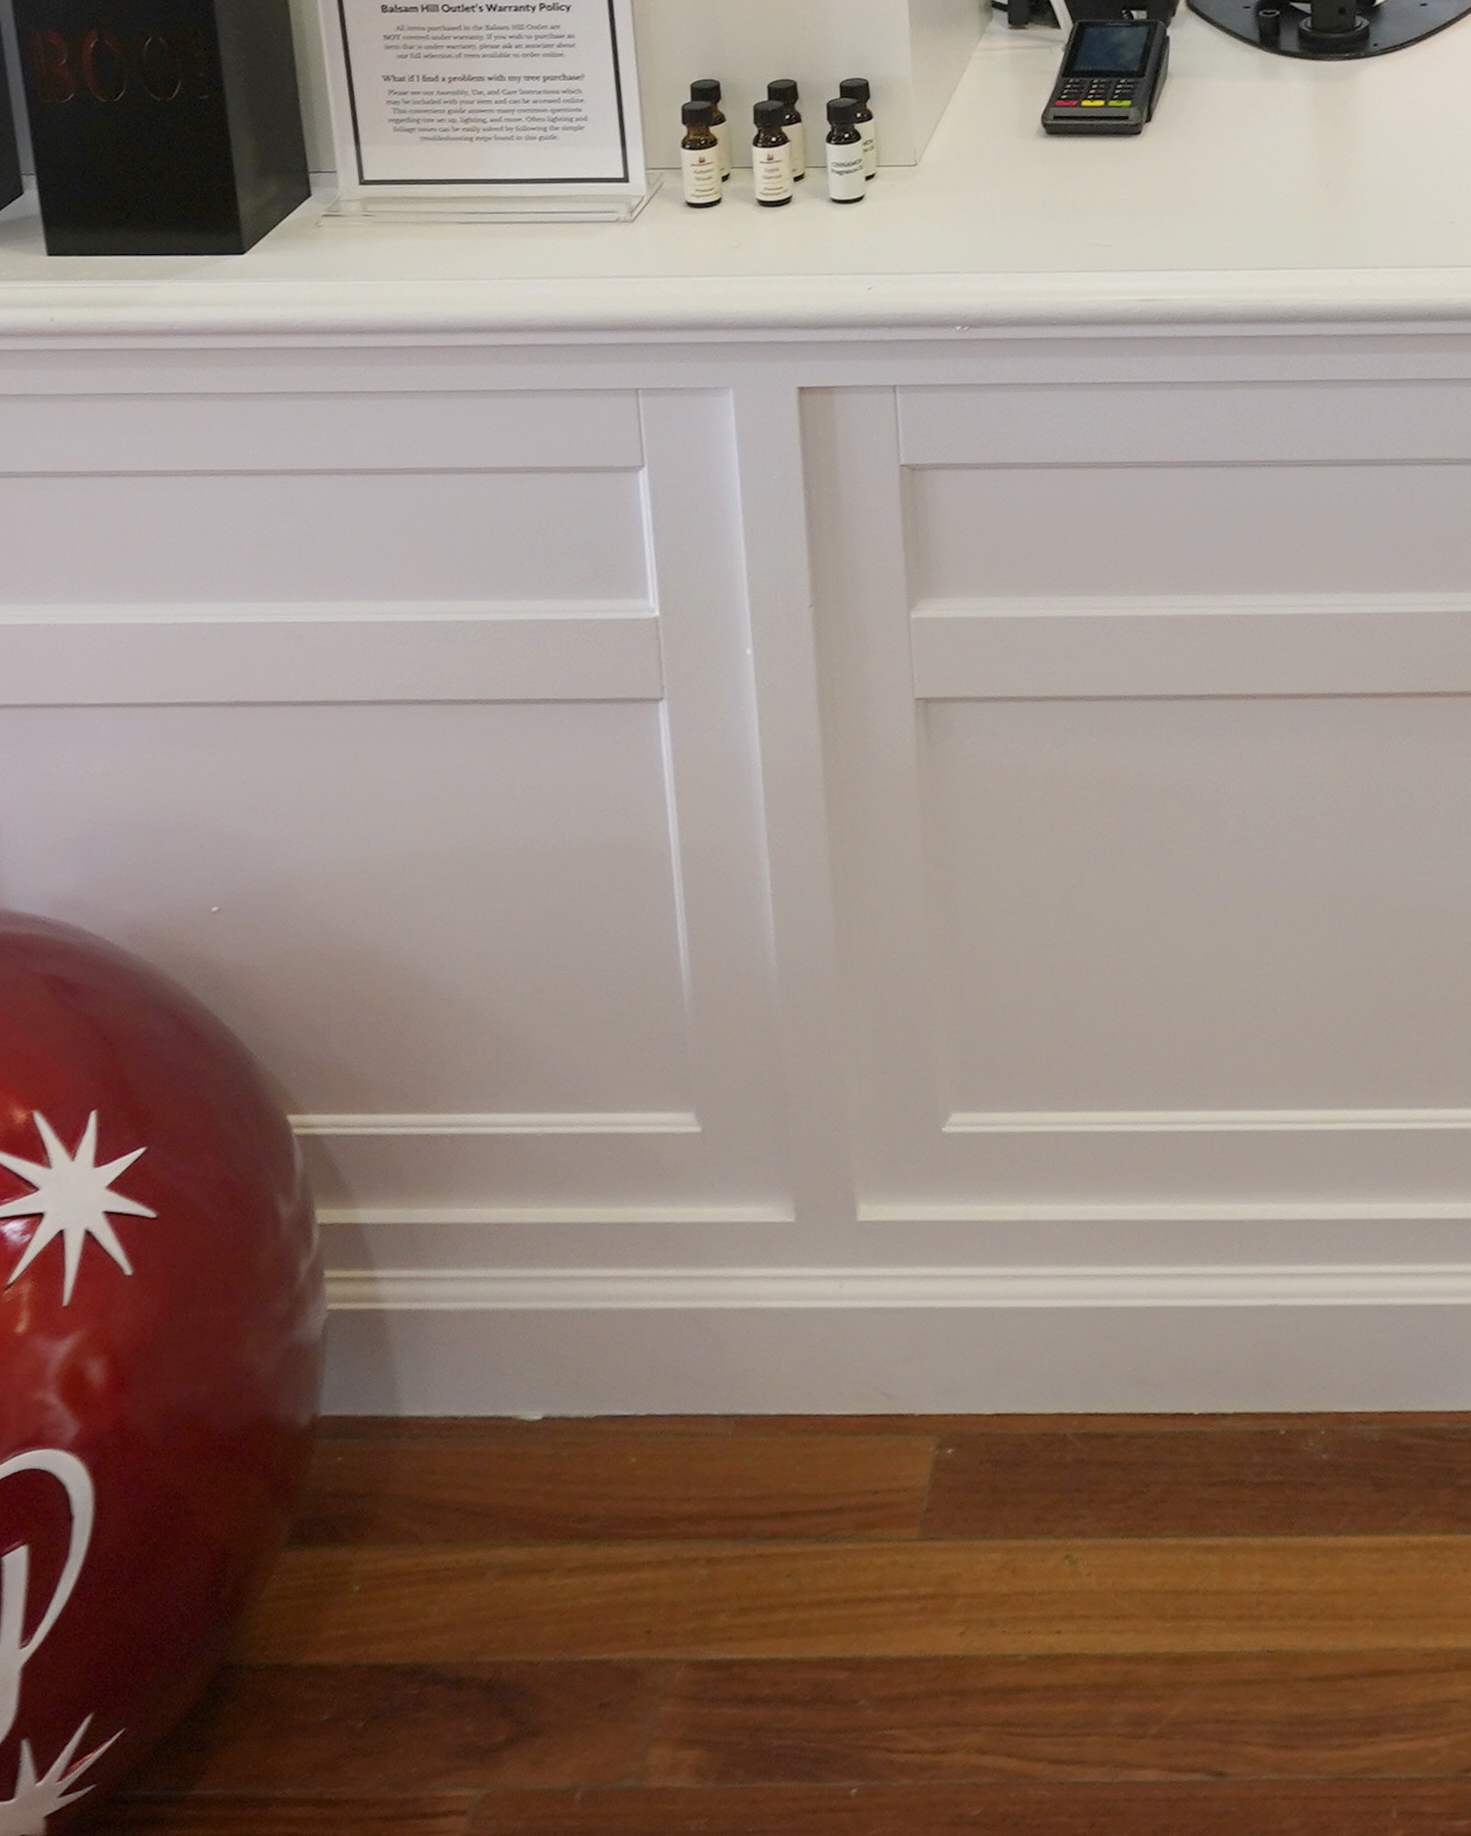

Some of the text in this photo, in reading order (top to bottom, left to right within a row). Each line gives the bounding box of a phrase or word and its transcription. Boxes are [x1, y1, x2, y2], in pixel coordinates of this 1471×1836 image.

[381, 2, 571, 13] Balsam Hill Outlet's Warranty Policy
